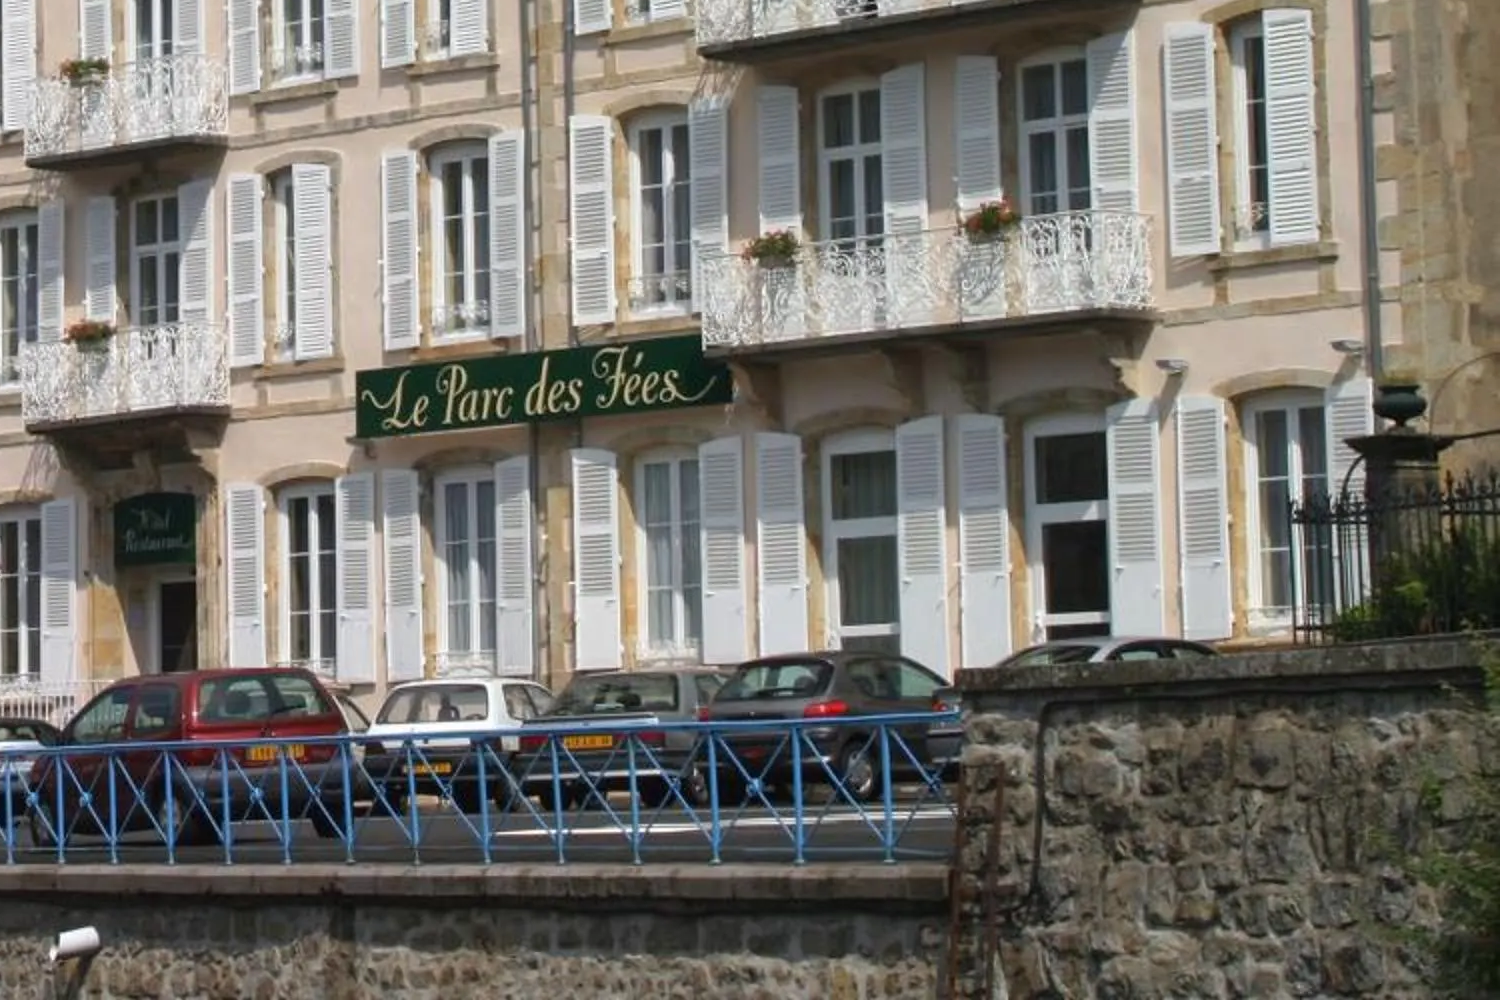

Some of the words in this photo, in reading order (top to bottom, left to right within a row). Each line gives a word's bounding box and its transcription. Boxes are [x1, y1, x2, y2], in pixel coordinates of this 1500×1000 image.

[362, 370, 429, 429] Le
[436, 364, 514, 425] Parc
[524, 357, 584, 417] des
[591, 346, 716, 410] Fées
